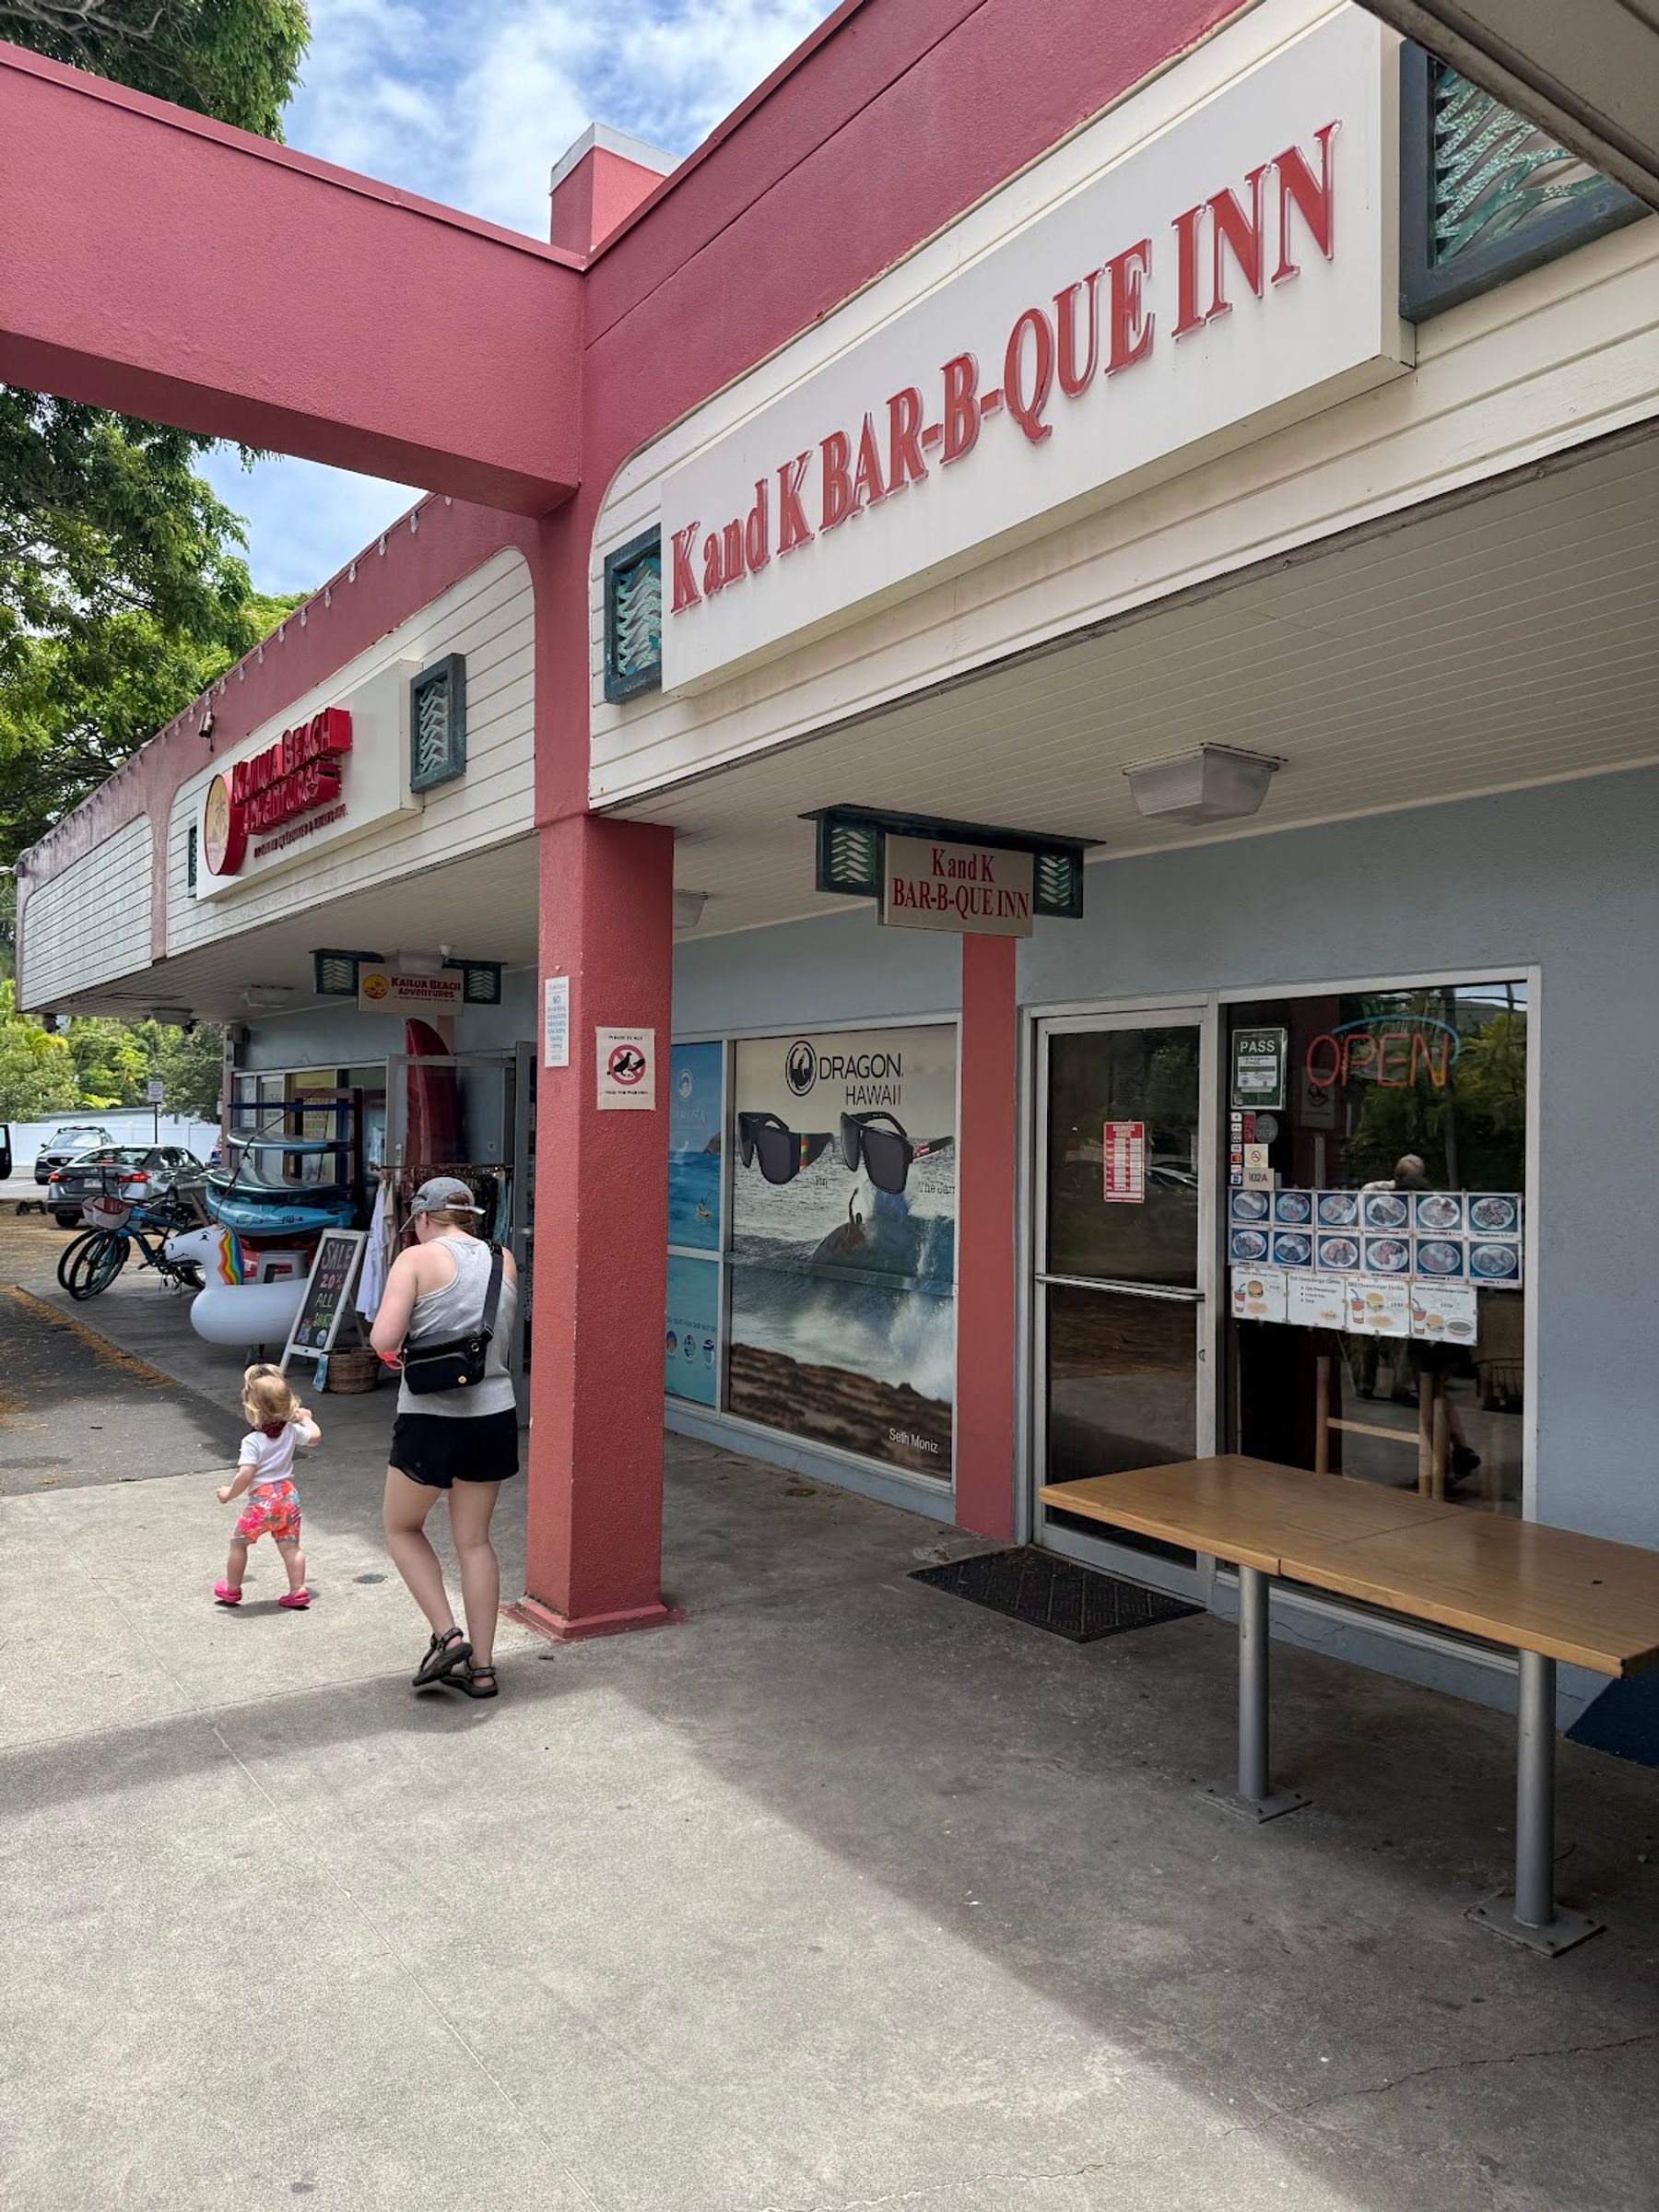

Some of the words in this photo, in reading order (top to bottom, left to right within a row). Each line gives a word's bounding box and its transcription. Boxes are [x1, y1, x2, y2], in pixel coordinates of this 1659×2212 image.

[671, 520, 702, 615] K
[702, 478, 771, 594] and
[776, 450, 815, 557] K
[818, 238, 1155, 534] BAR-B-QUE
[1171, 117, 1343, 341] INN
[932, 848, 947, 877] K
[948, 853, 977, 881] and
[981, 854, 995, 883] K
[892, 878, 994, 920] BAR-B-QUE
[997, 890, 1030, 919] INN
[391, 977, 428, 989] KAILUA
[429, 980, 461, 991] BEACH
[1240, 1041, 1276, 1053] PASS
[1306, 1032, 1449, 1088] OPEN
[819, 1053, 901, 1080] DRAGON
[845, 1084, 901, 1105] HAWAII
[1248, 1173, 1268, 1182] 102A
[322, 1241, 354, 1270] SALE
[315, 1292, 333, 1308] ALL
[888, 1428, 910, 1445] Seth
[911, 1434, 939, 1454] Moniz
